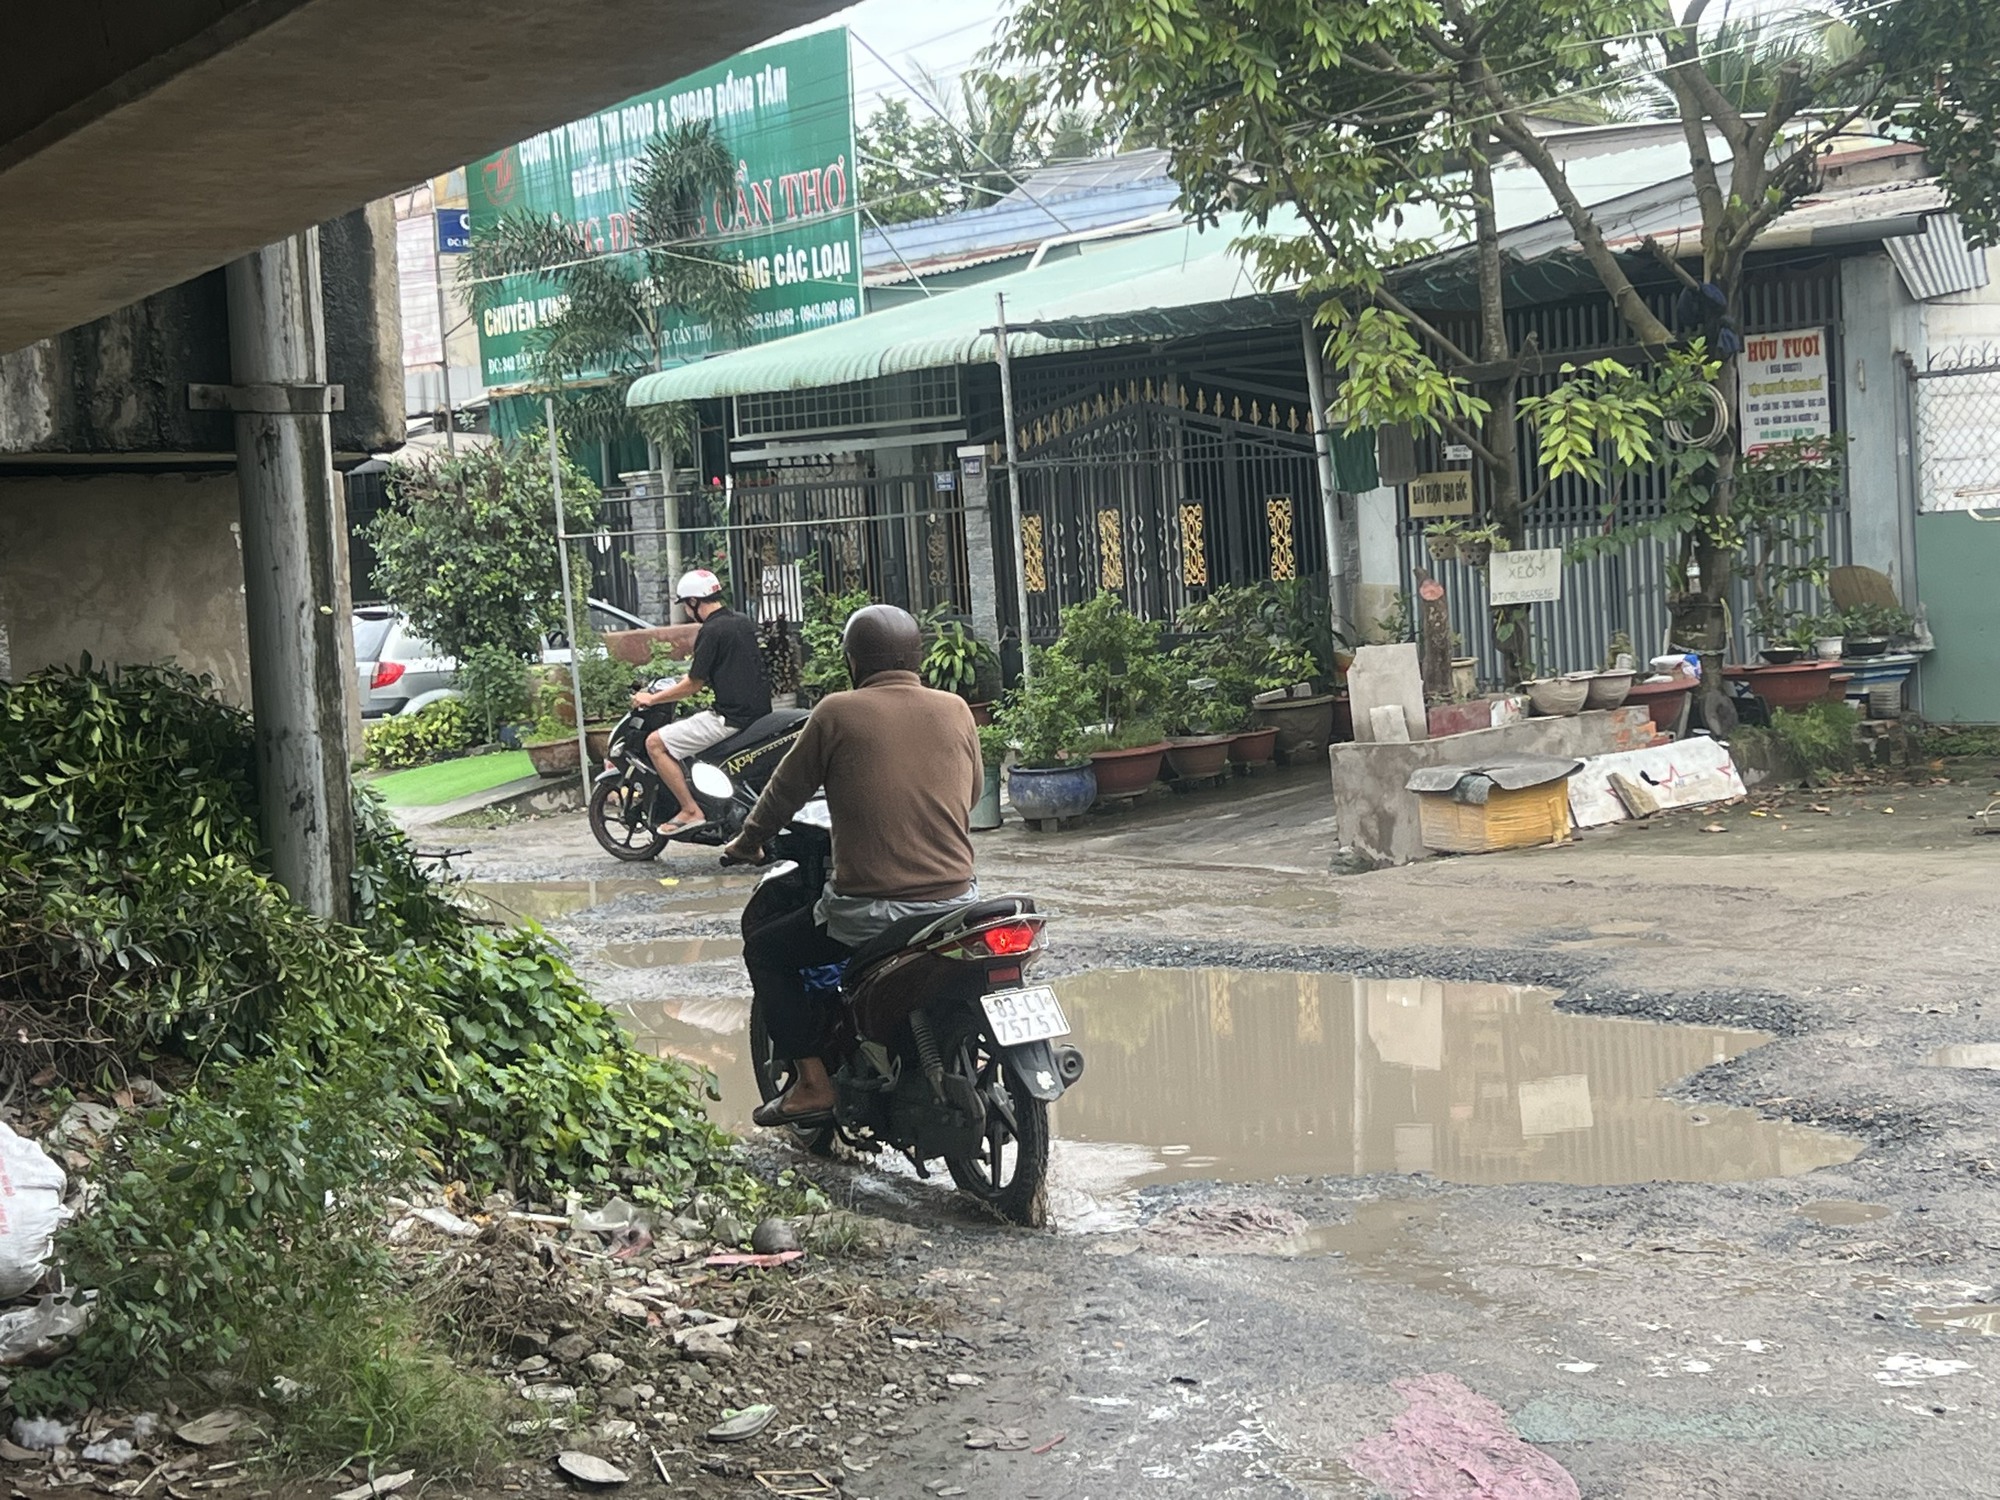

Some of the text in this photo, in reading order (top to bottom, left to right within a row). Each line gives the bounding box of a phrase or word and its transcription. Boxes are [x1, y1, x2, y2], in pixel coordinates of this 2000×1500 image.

[567, 116, 600, 153] TNHH
[600, 111, 621, 148] TM
[621, 102, 654, 141] FOOD
[670, 86, 714, 128] SUGAR
[756, 63, 788, 107] TÂM
[779, 154, 847, 222] THƠ
[484, 297, 537, 337] CHUYÊN
[774, 245, 808, 286] CÁC
[811, 240, 851, 282] LOẠI
[994, 992, 1046, 1018] 83-C1
